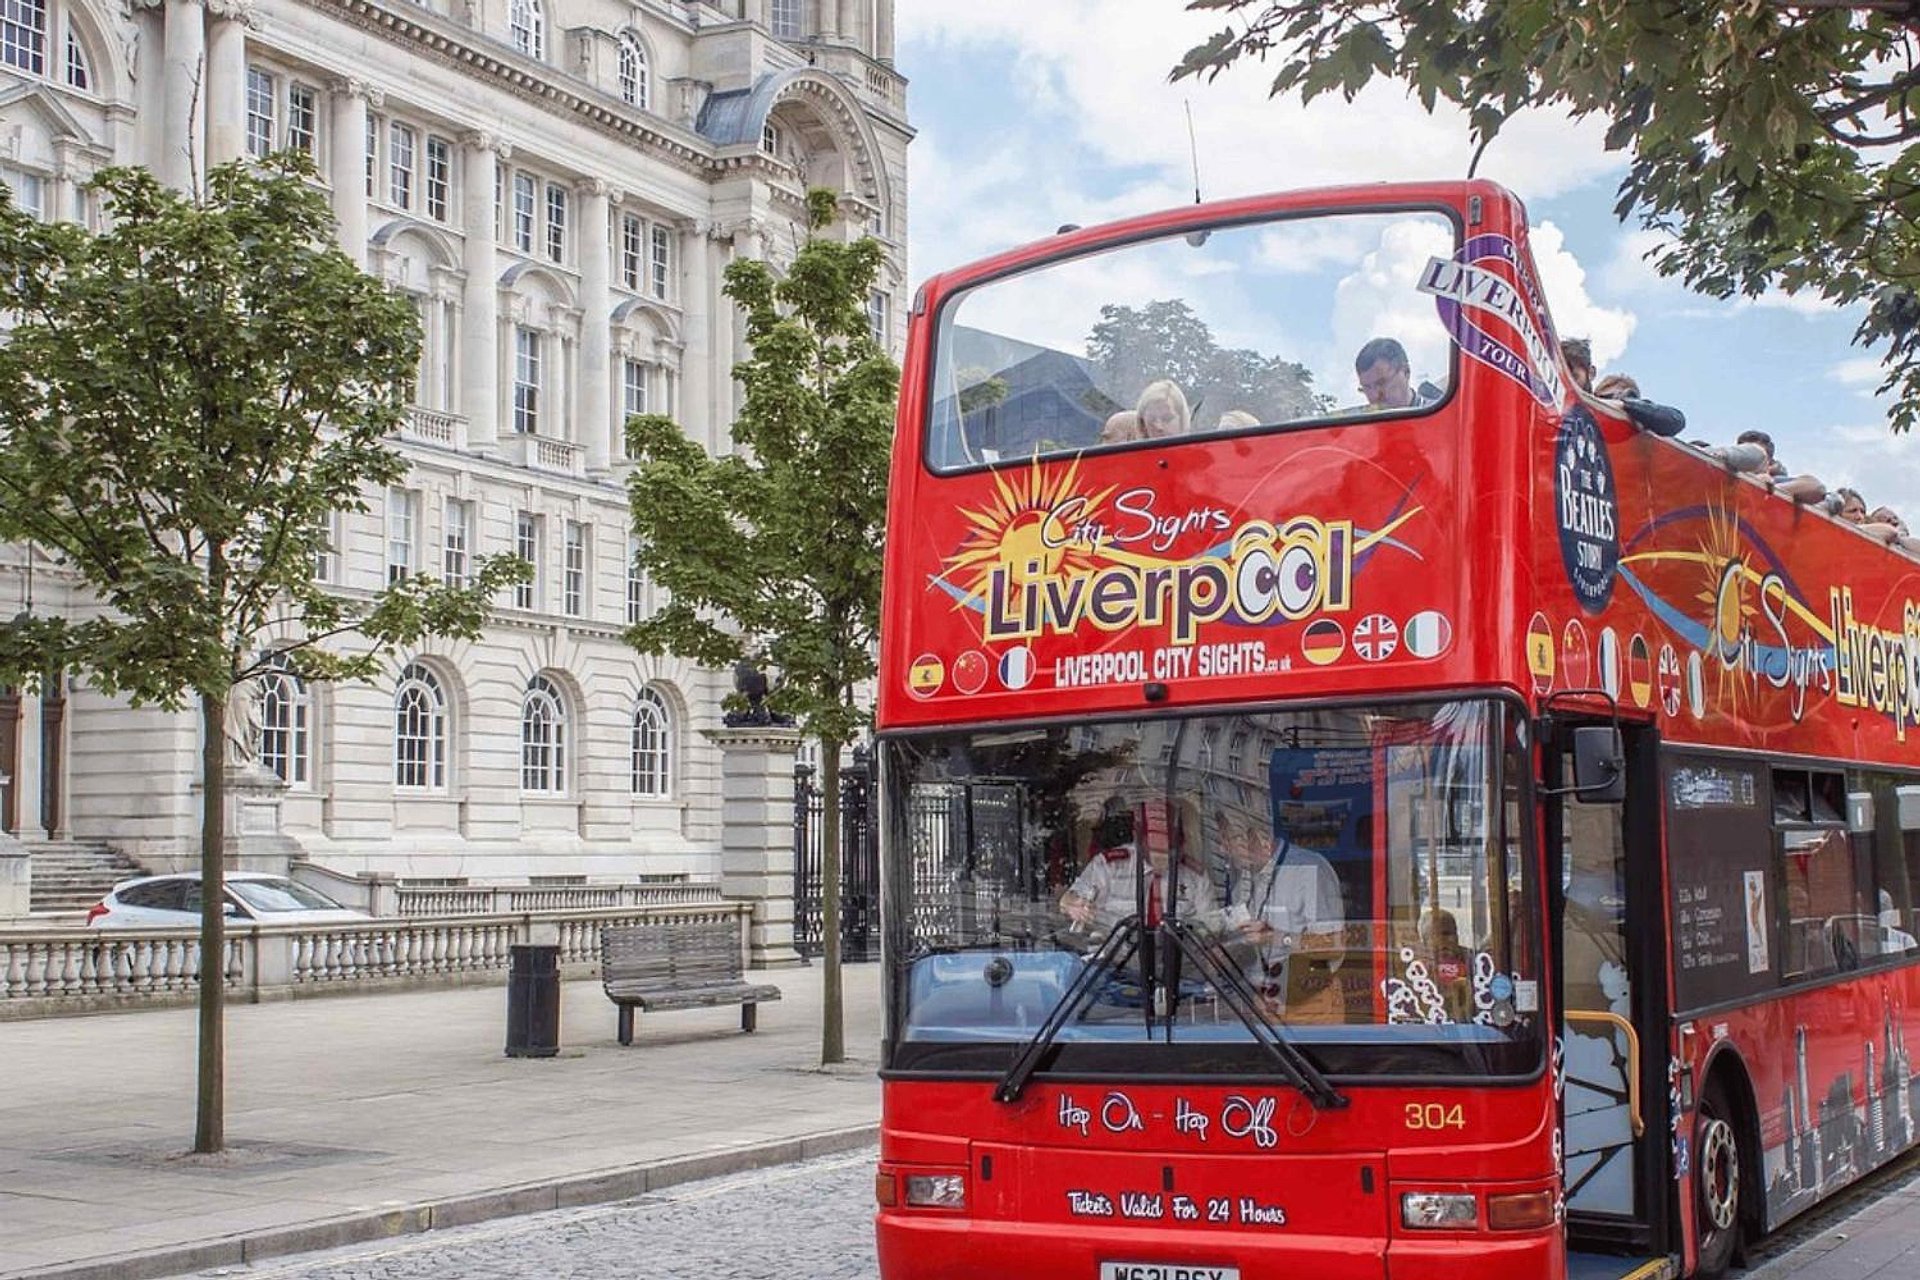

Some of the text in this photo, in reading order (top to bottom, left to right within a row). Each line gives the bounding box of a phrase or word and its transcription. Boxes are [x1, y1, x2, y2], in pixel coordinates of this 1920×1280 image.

[1427, 261, 1558, 395] LIVERPOOL
[1479, 336, 1527, 381] TOUR
[1042, 488, 1231, 552] City Sights
[1560, 463, 1614, 541] BEATLES
[985, 518, 1353, 643] Liverpool
[1055, 651, 1148, 687] LIVERPOOL
[1153, 646, 1193, 680] CITY
[1830, 585, 1920, 742] Liverpo
[1059, 1093, 1091, 1137] Hop
[1101, 1091, 1144, 1132] On
[1174, 1097, 1209, 1141] Hop
[1221, 1095, 1279, 1148] Off
[1405, 1103, 1466, 1130] 304
[1067, 1192, 1286, 1225] Tickets Valid For 24 Hours
